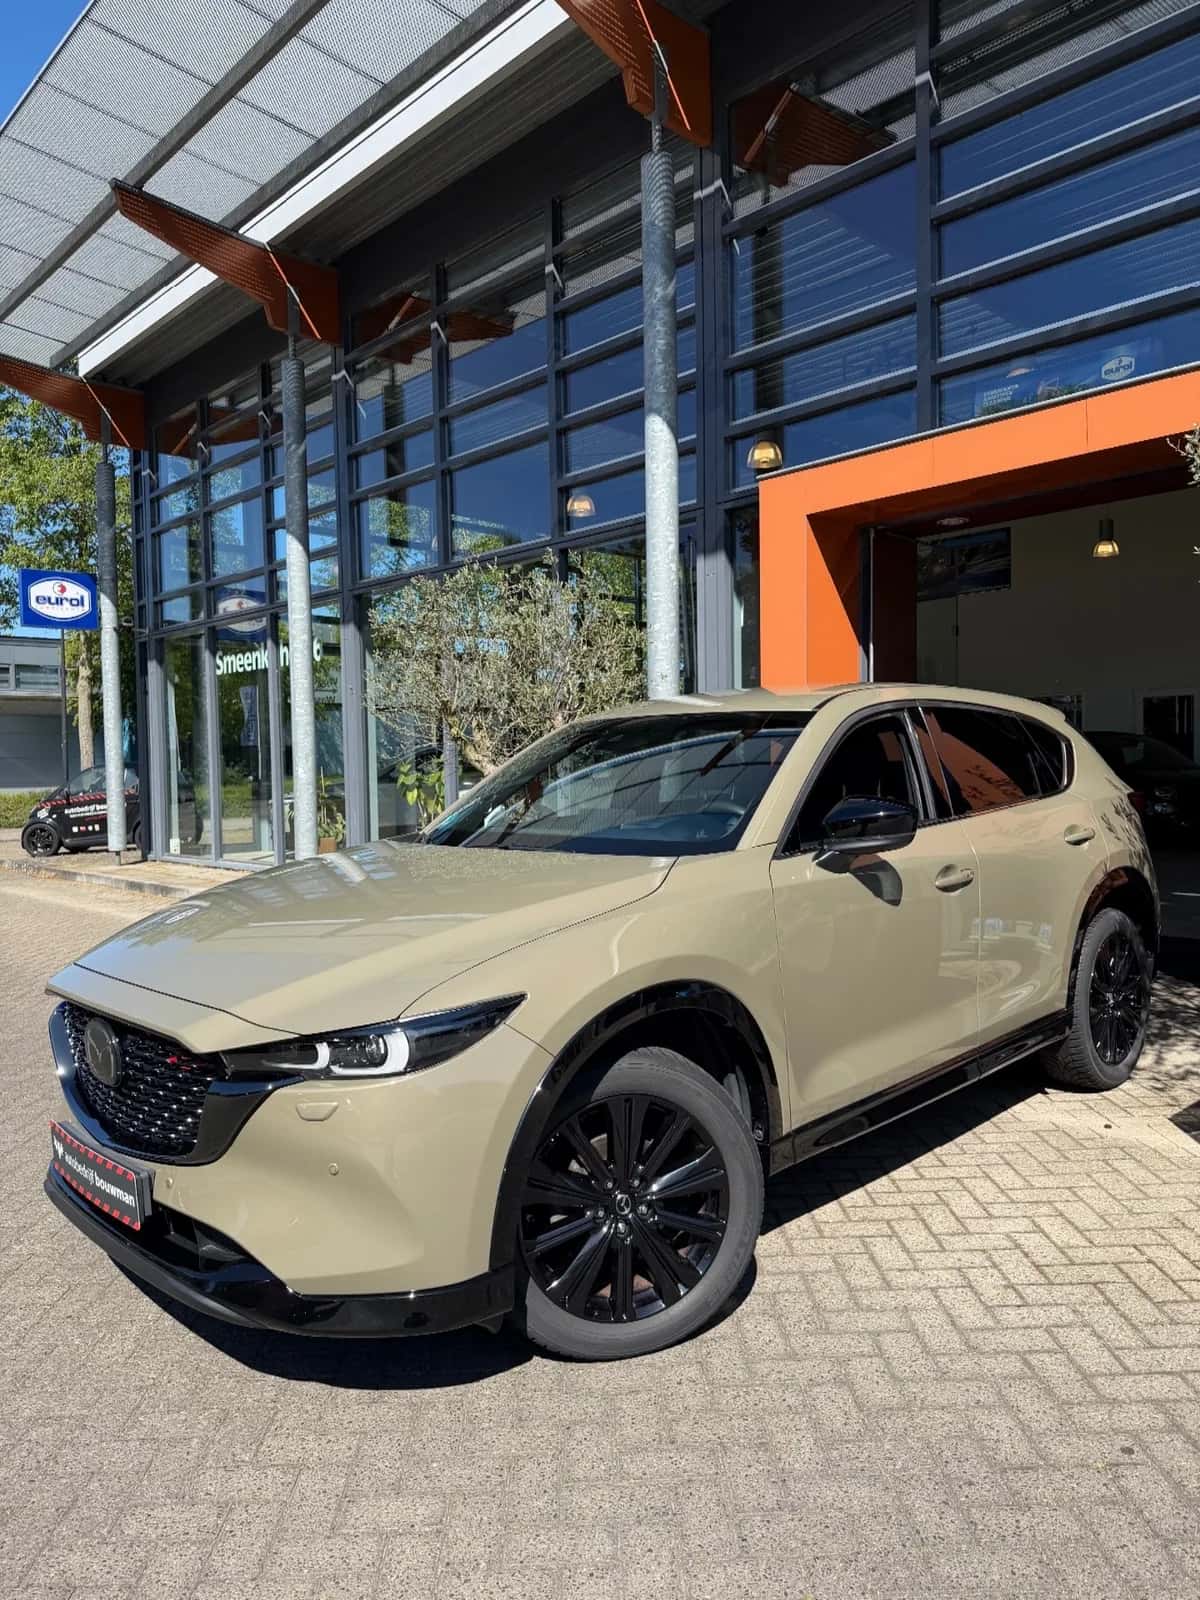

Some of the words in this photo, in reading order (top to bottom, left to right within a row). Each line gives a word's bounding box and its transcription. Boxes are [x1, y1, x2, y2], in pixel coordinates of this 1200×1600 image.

[35, 595, 85, 607] eurol
[312, 637, 321, 662] 6
[64, 1151, 95, 1185] autobedrijf
[94, 1171, 136, 1208] bouwman
